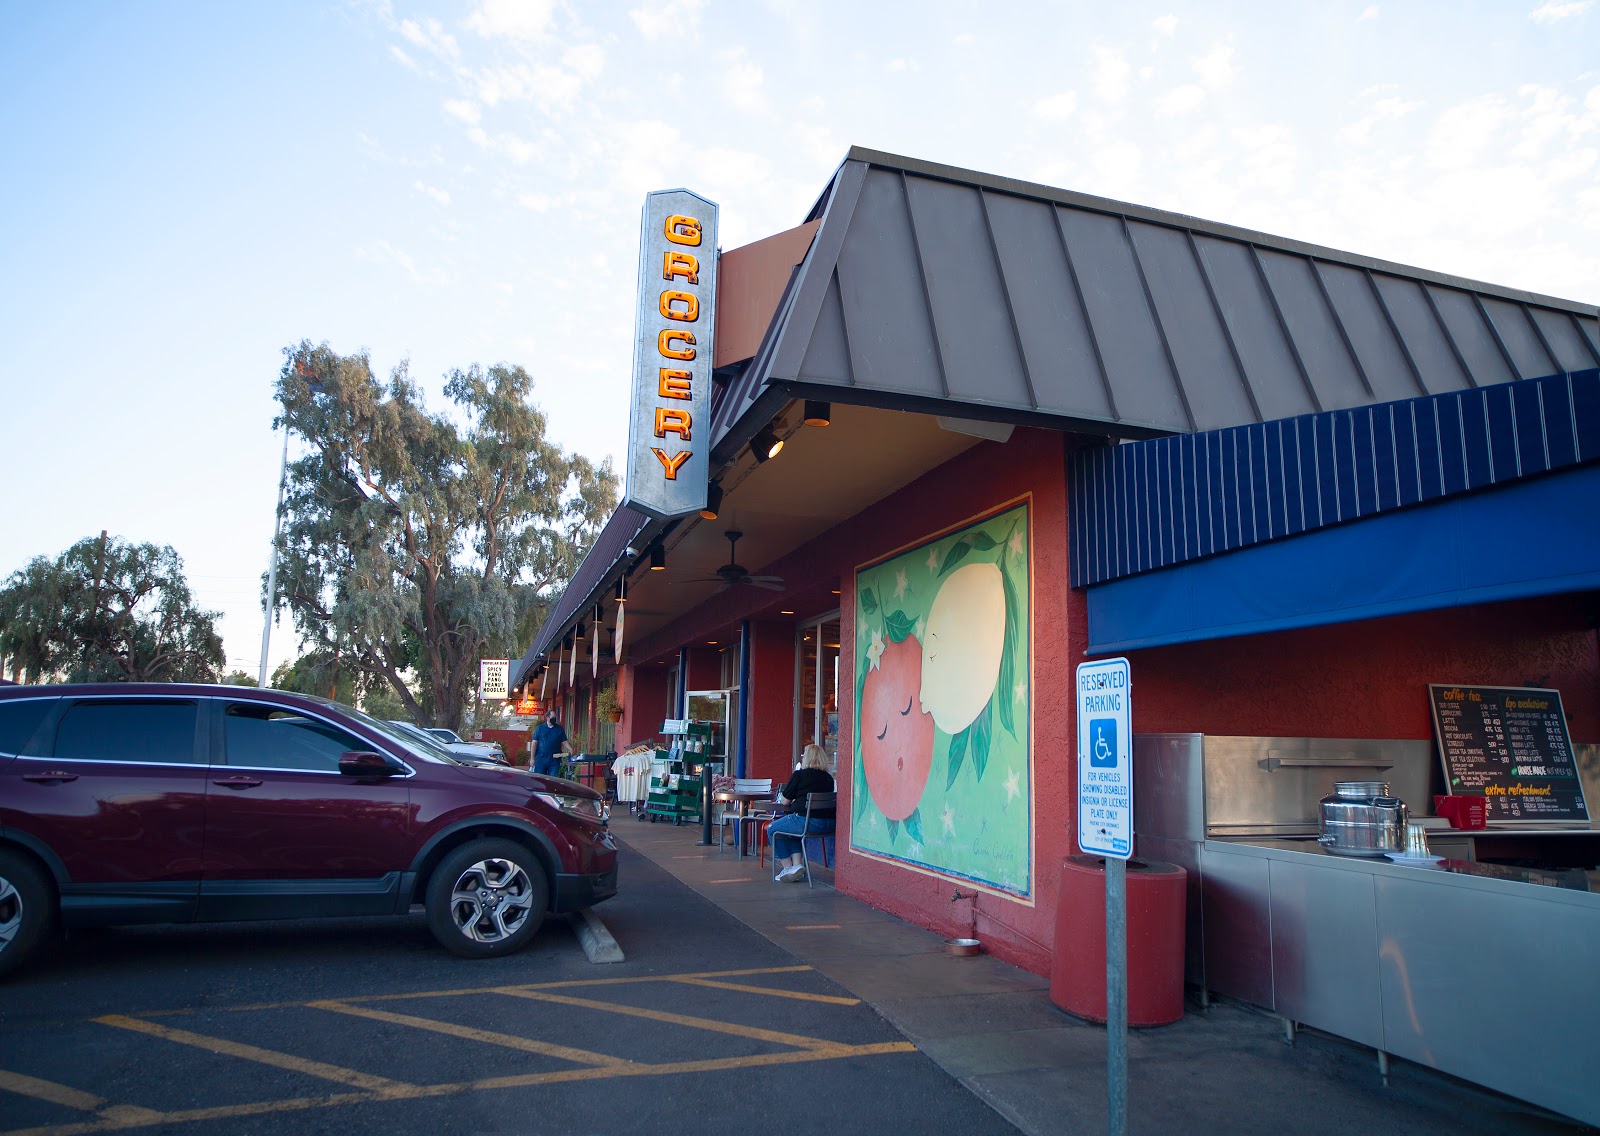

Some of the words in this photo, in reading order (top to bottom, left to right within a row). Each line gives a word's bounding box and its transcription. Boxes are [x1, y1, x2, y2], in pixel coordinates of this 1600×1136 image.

[650, 214, 702, 480] GROCERY
[1081, 671, 1124, 691] RESERVED
[1444, 688, 1464, 701] coffee
[1468, 690, 1482, 701] tea
[1086, 694, 1120, 712] PARKING
[1518, 698, 1548, 709] exclusives
[1517, 766, 1532, 775] HOUSE
[1532, 766, 1547, 775] MADE
[1088, 772, 1096, 780] FOR
[1098, 773, 1120, 782] VEHICLES
[1083, 784, 1102, 793] SHOWING
[1104, 785, 1127, 795] DISABLED
[1485, 784, 1506, 795] extra
[1508, 783, 1551, 795] refreshment
[1082, 796, 1100, 805] INSIGNIA
[1101, 797, 1107, 806] OR
[1109, 798, 1128, 808] LICENSE
[1091, 809, 1105, 818] PLATE
[1106, 810, 1118, 820] ONLY
